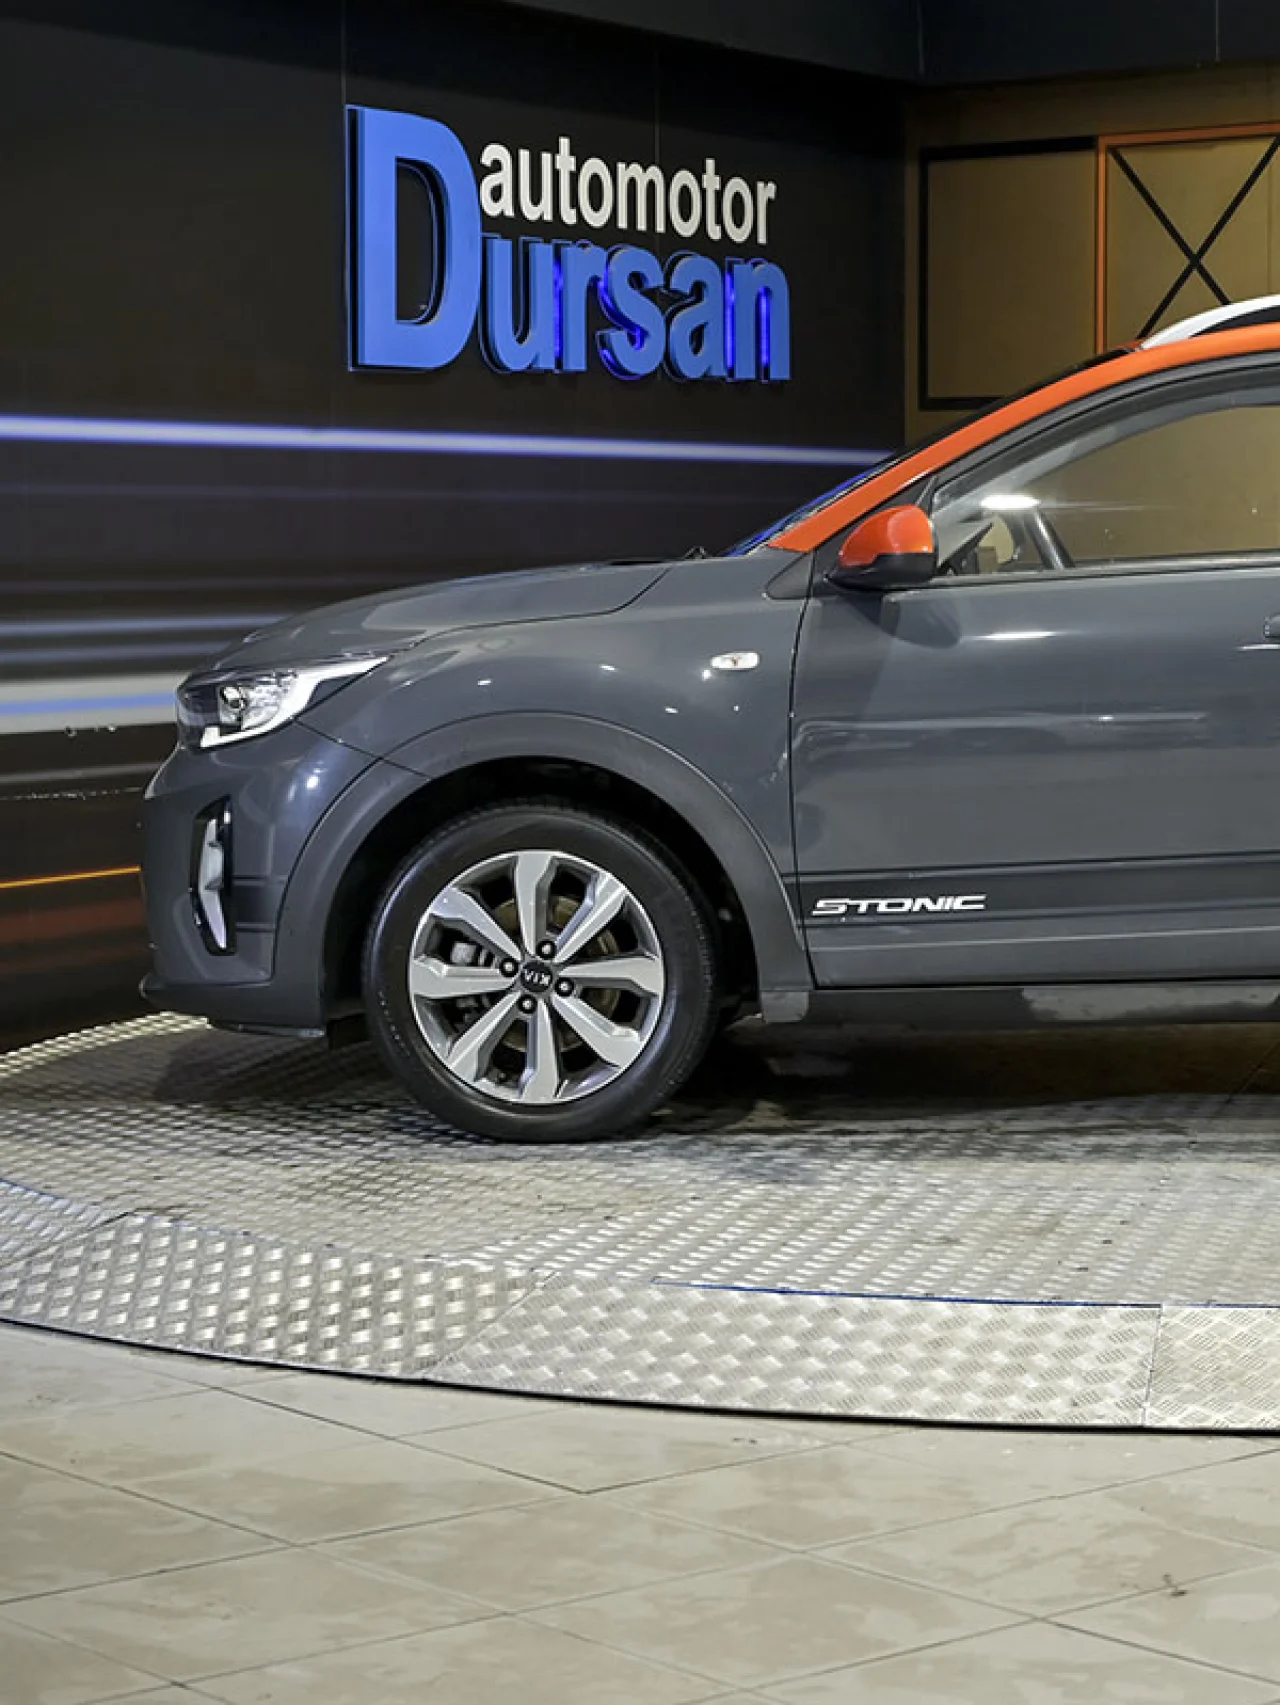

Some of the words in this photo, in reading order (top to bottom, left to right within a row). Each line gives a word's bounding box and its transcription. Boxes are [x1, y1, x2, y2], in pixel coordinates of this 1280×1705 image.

[346, 104, 791, 382] Dursan
[479, 137, 777, 244] automotor
[812, 894, 987, 916] STONIC
